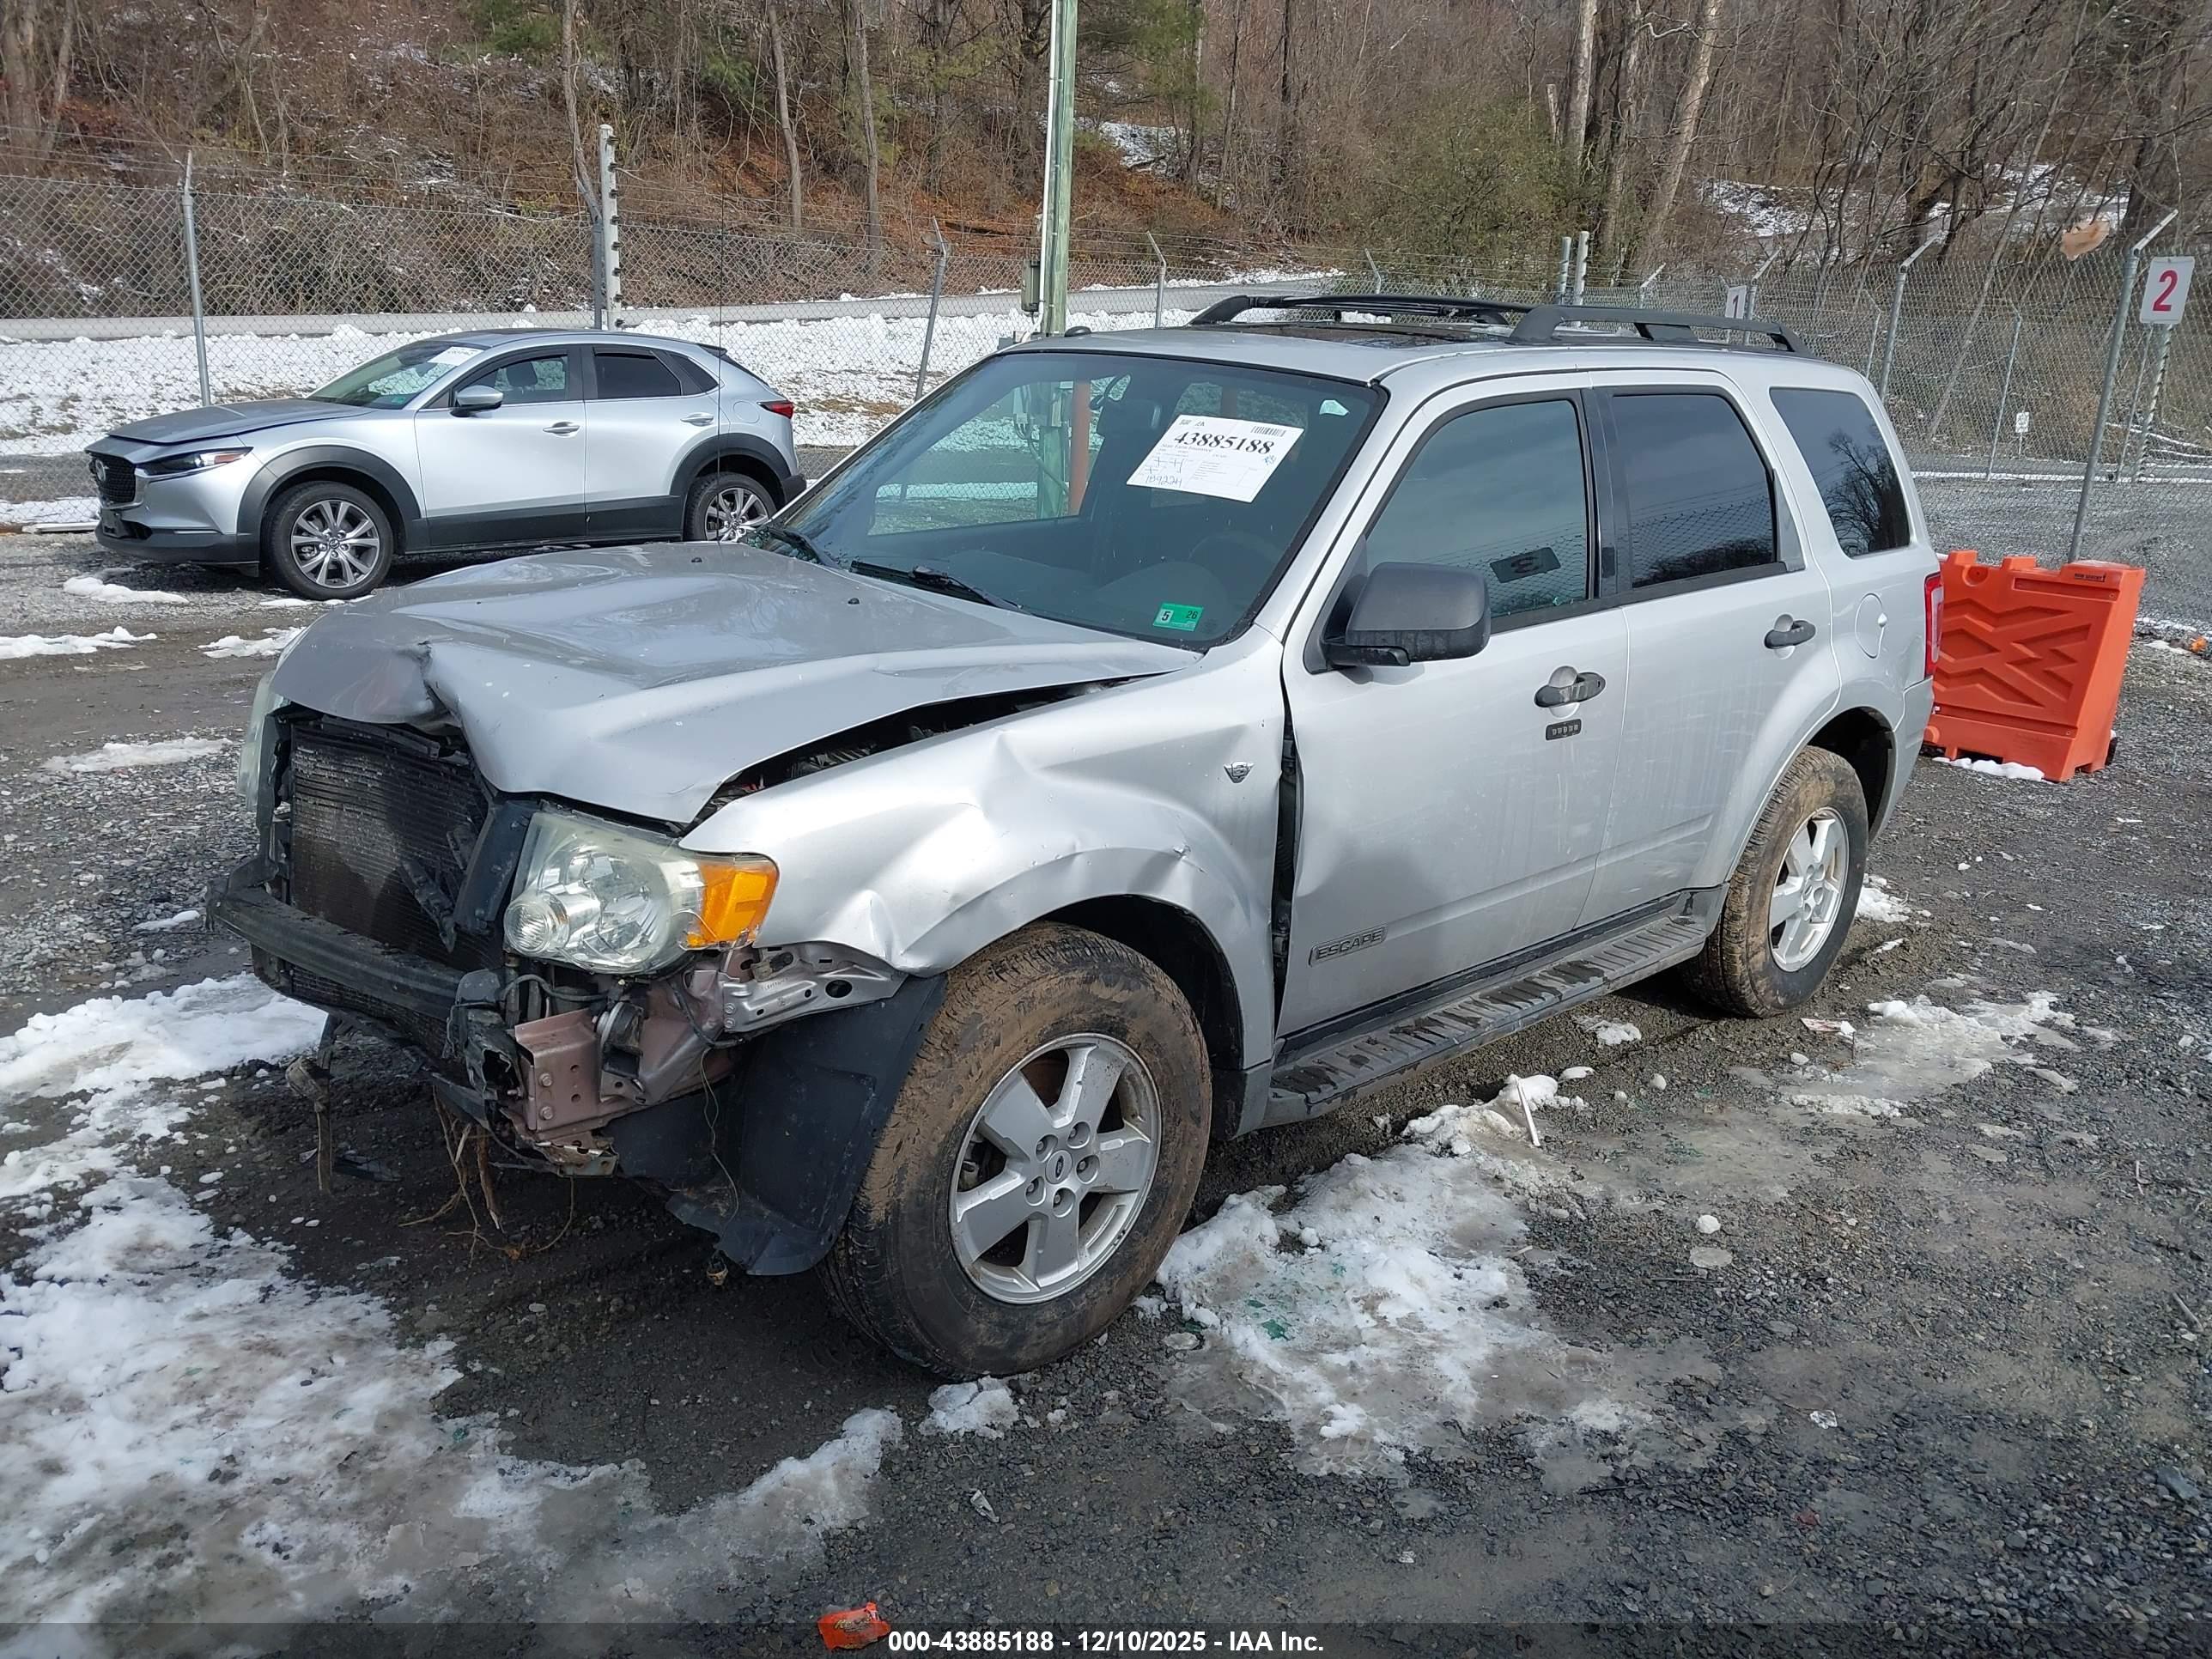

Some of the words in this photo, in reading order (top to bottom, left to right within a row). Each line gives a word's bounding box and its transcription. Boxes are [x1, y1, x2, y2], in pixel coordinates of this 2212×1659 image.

[2152, 270, 2179, 312] 2
[1732, 295, 1740, 319] 1
[1174, 431, 1275, 454] 43885188
[1161, 611, 1171, 621] 5
[1185, 610, 1199, 620] 26
[1316, 930, 1382, 959] ESCAPE
